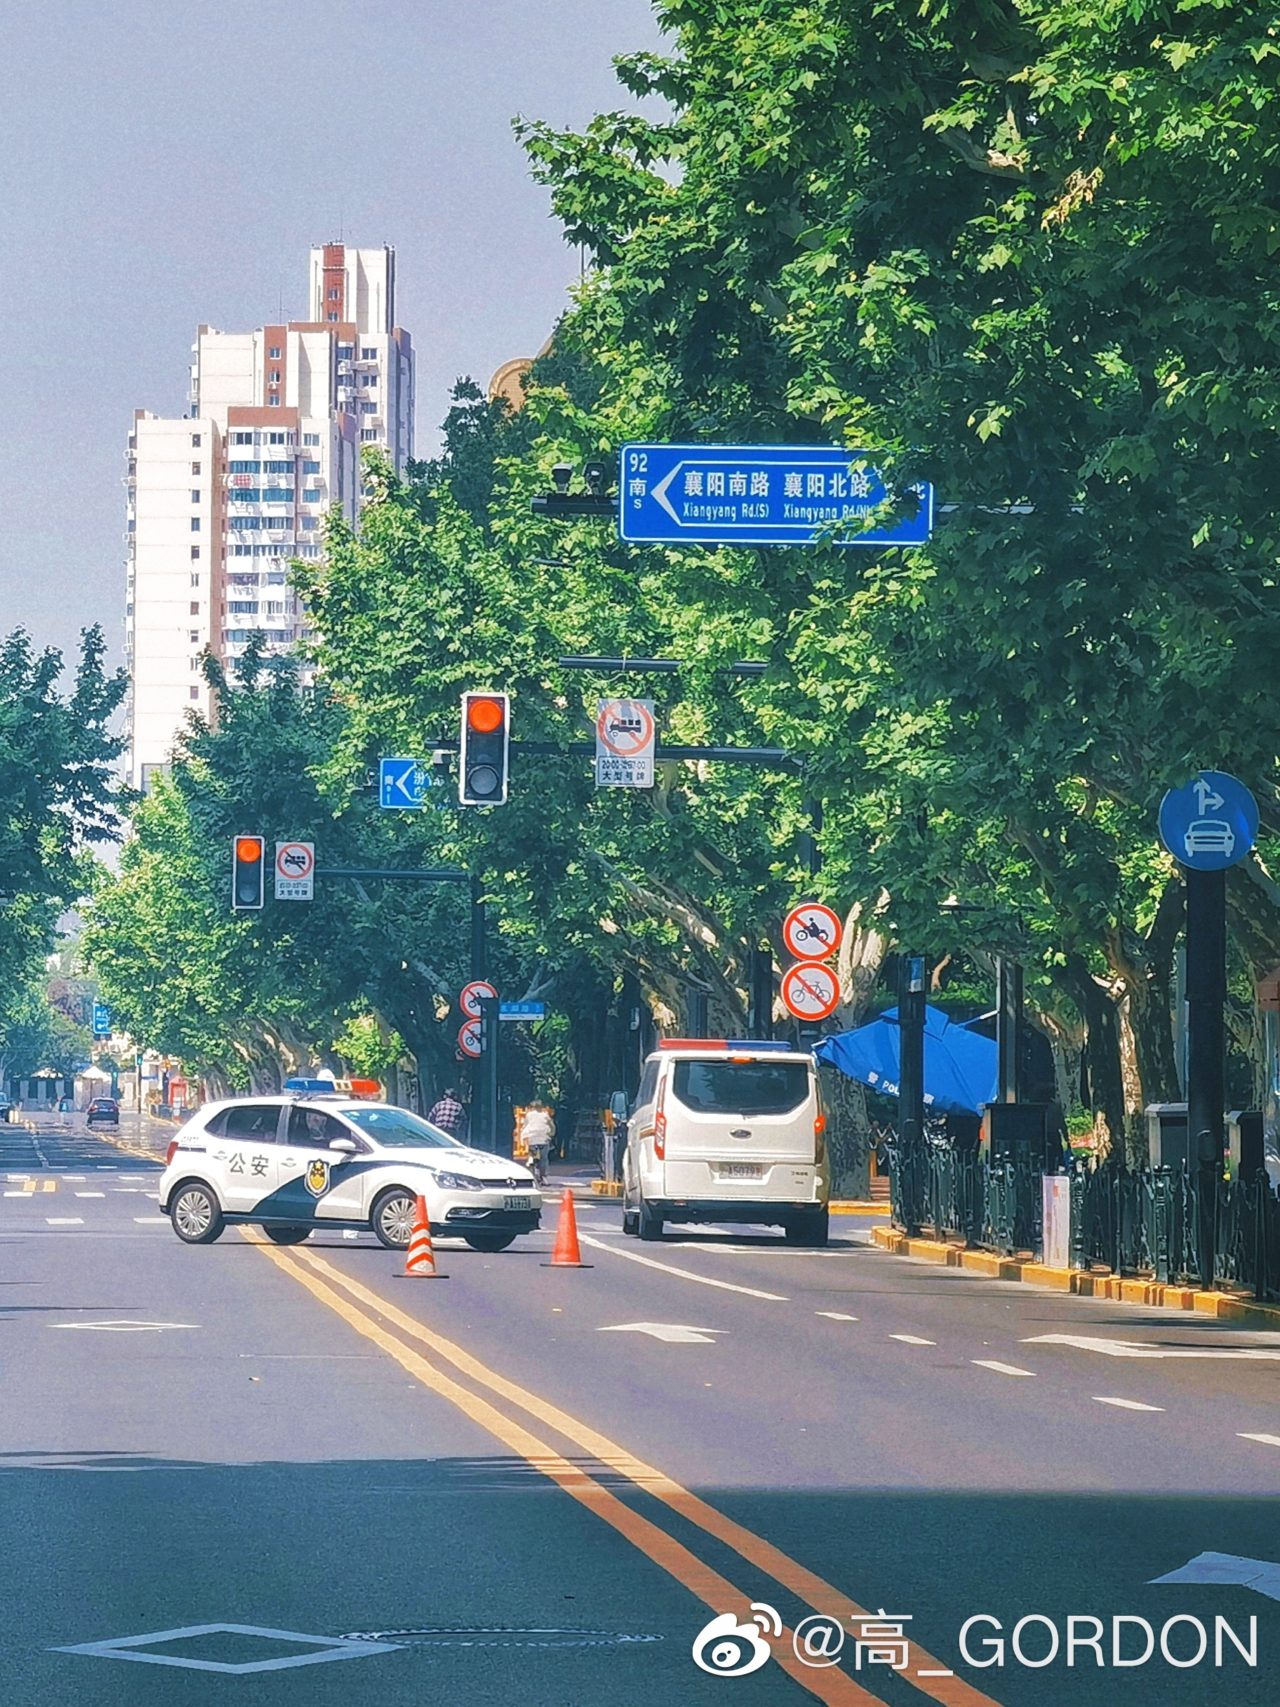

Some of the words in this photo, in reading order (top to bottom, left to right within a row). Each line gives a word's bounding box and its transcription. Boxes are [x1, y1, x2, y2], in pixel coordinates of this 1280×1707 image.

[629, 453, 648, 472] 92
[629, 478, 648, 497] 南
[684, 470, 770, 498] 襄阳南路
[784, 472, 869, 499] 襄阳北路
[633, 499, 642, 509] S
[683, 502, 737, 522] Xiangyang
[228, 1152, 270, 1178] 公安
